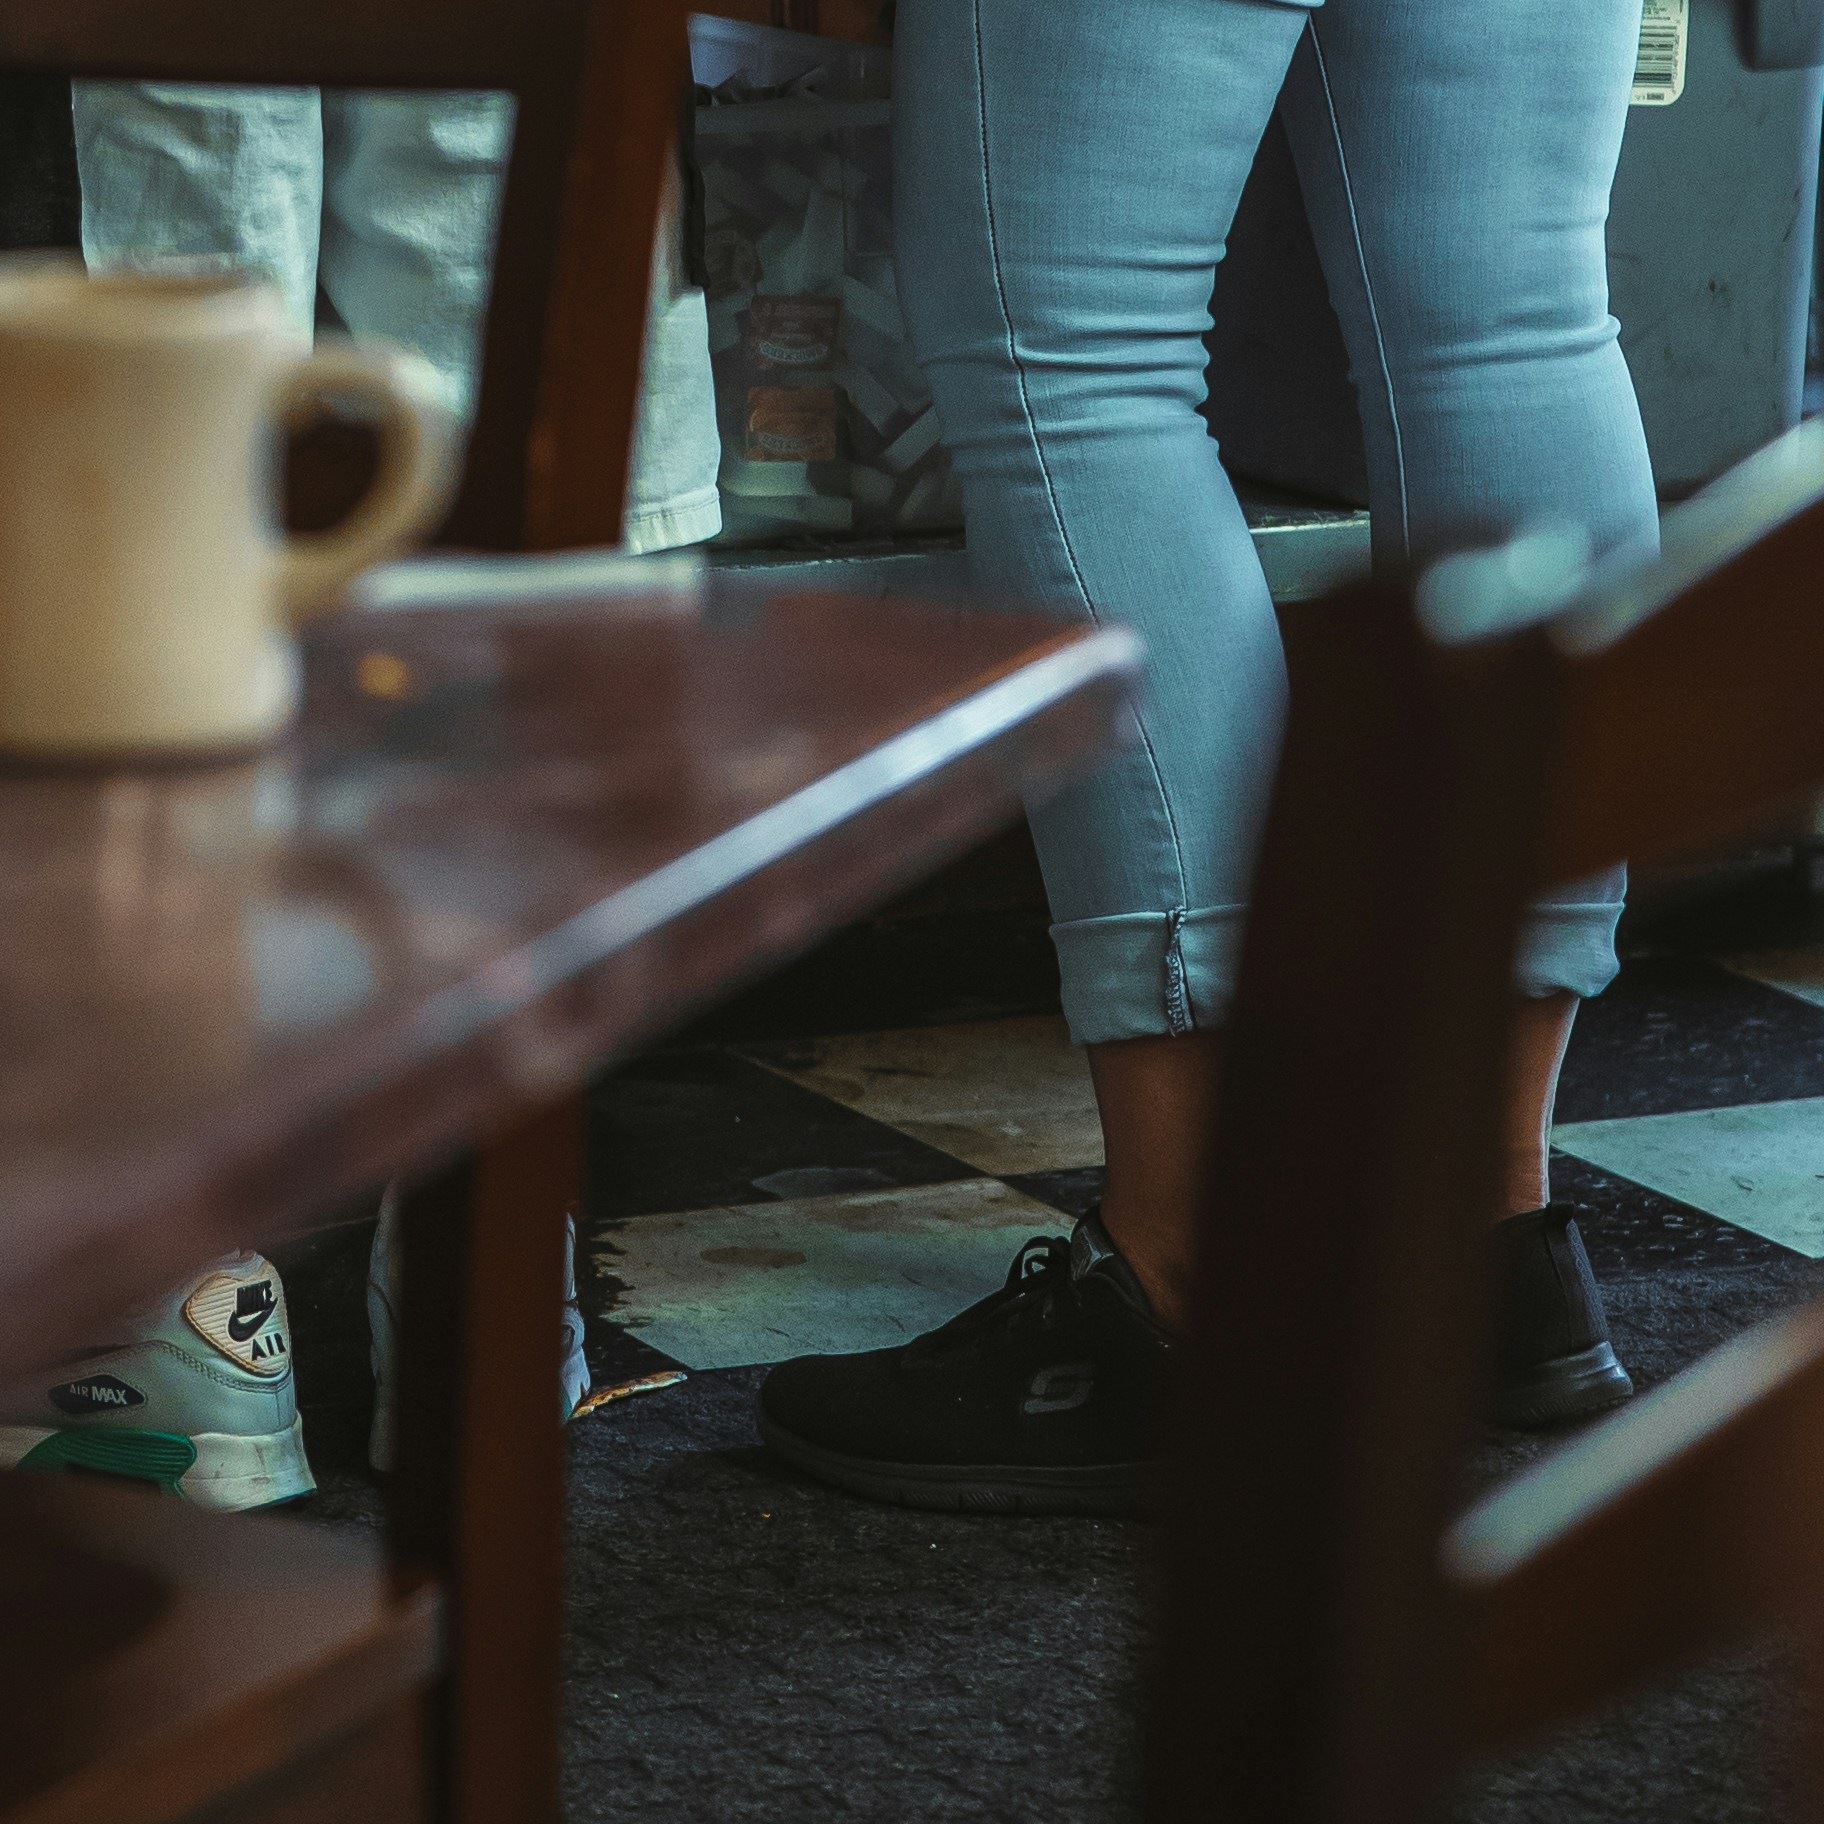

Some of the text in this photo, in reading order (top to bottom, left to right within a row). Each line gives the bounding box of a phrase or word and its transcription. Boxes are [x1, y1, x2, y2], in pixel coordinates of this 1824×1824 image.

[236, 1279, 273, 1319] NIKE
[251, 1332, 286, 1362] AIR
[69, 1383, 127, 1405] AIR MAX
